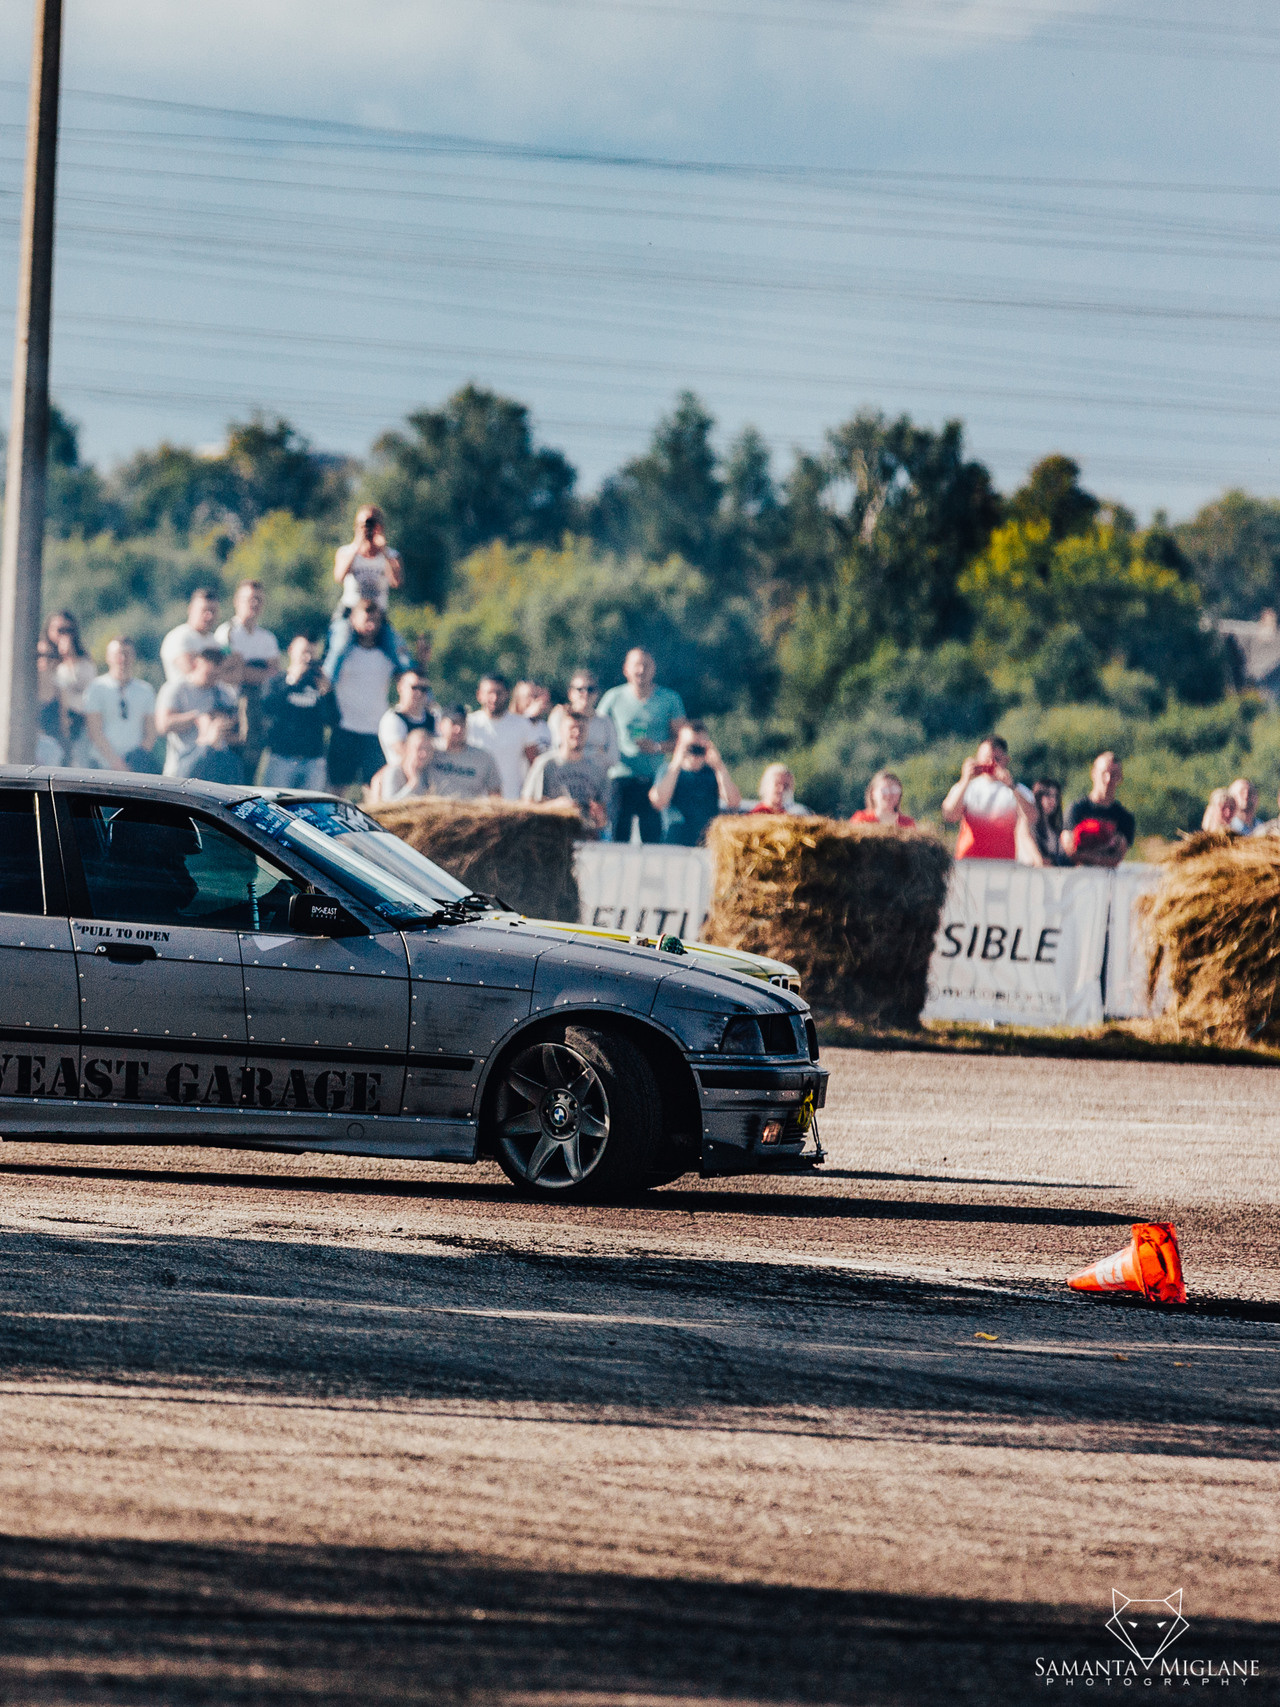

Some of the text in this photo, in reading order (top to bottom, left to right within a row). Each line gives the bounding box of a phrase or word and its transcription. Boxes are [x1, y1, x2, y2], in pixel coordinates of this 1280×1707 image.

[81, 925, 170, 942] PULL TO OPEN
[941, 923, 1062, 964] SIBLE
[165, 1062, 382, 1112] GARAGE
